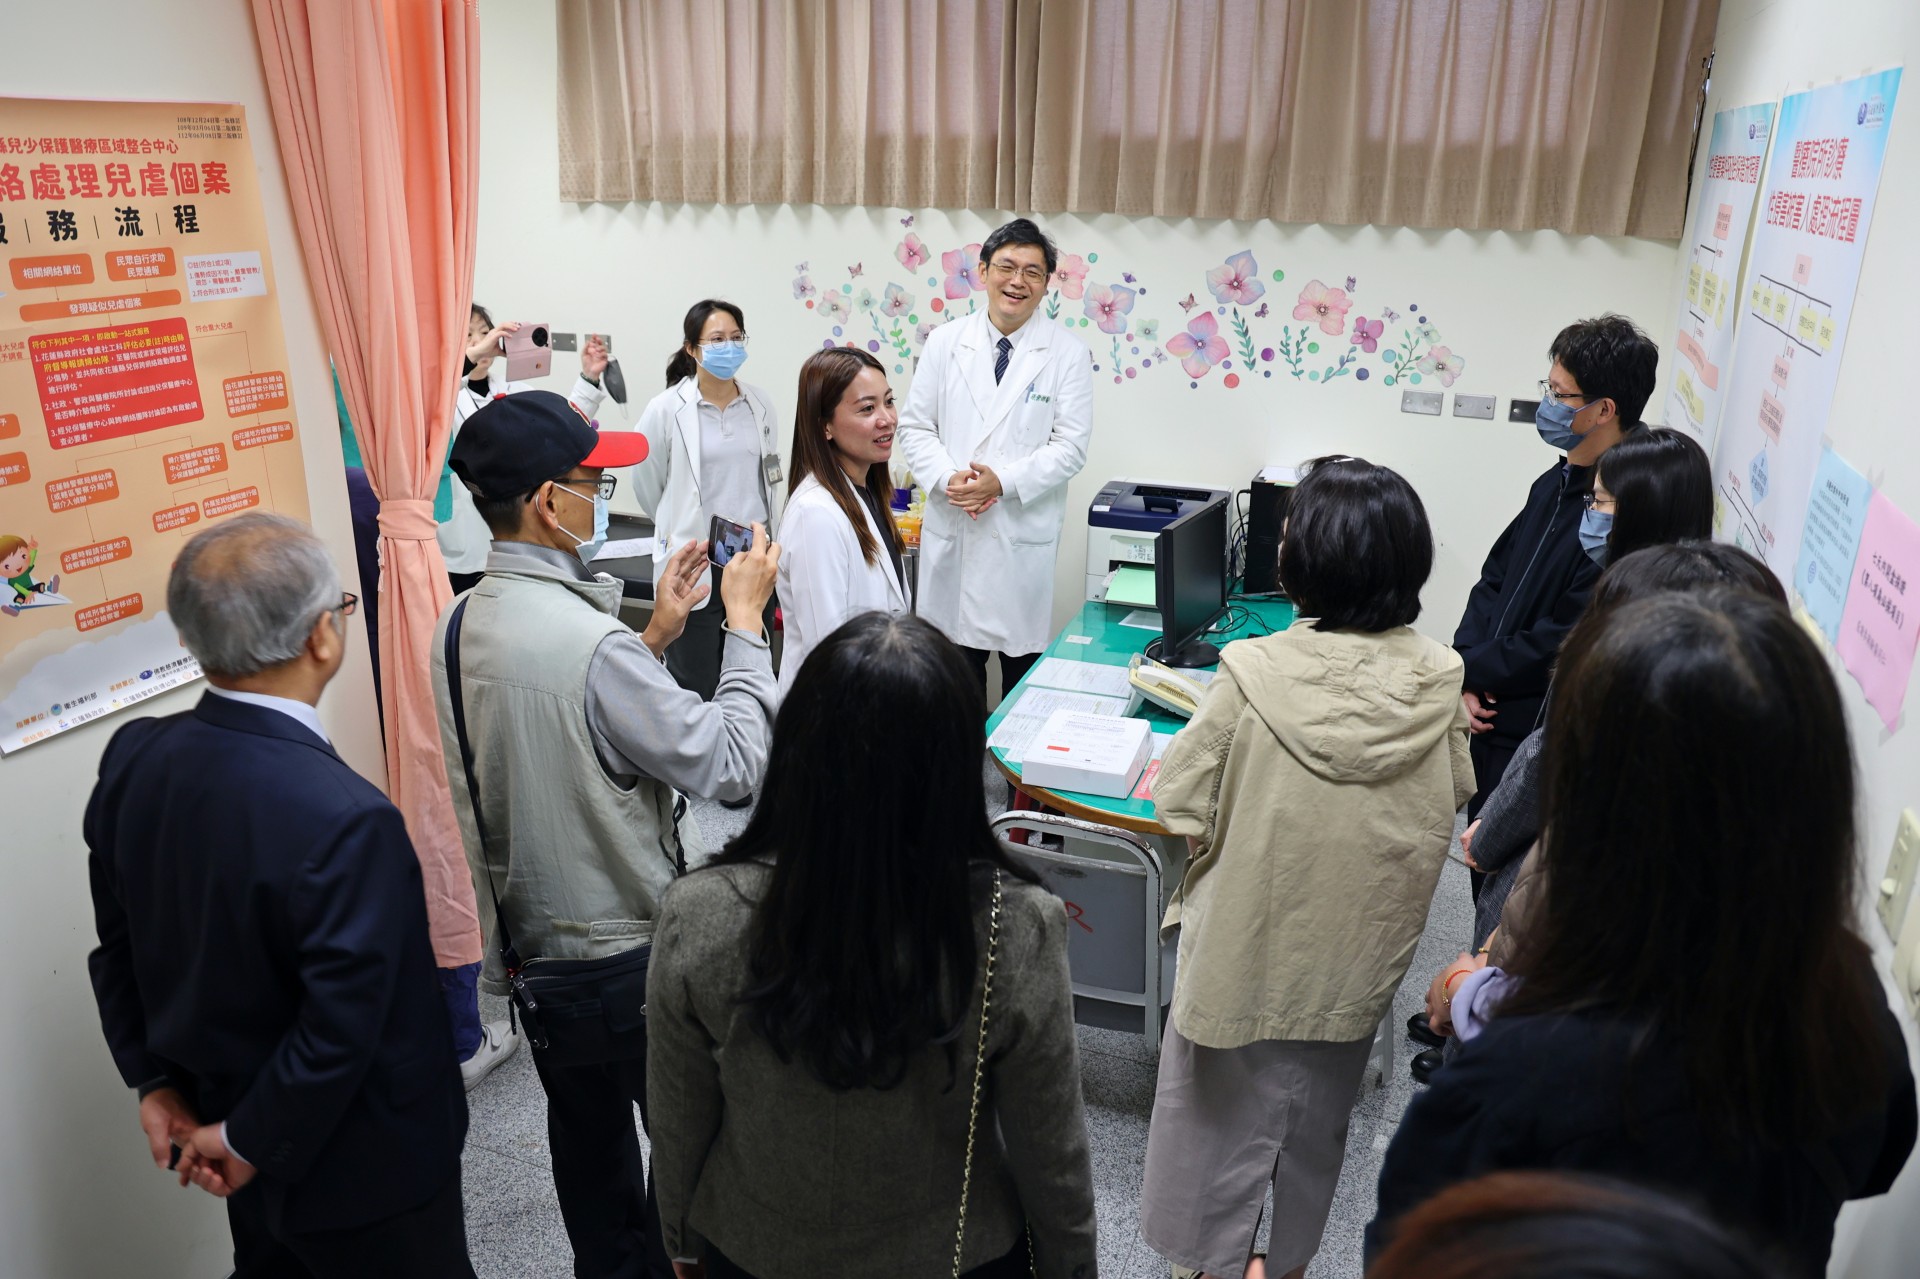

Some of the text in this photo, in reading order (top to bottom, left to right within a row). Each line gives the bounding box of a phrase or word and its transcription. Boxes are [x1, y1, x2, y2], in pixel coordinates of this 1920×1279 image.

[46, 205, 200, 242] 務 流 程
[116, 253, 166, 267] 民眾自行求助
[23, 263, 82, 279] 相關網絡單位
[127, 266, 160, 278] 民眾通報
[69, 298, 142, 314] 發現疑似兒虐個案
[0, 341, 24, 353] 大兒虐
